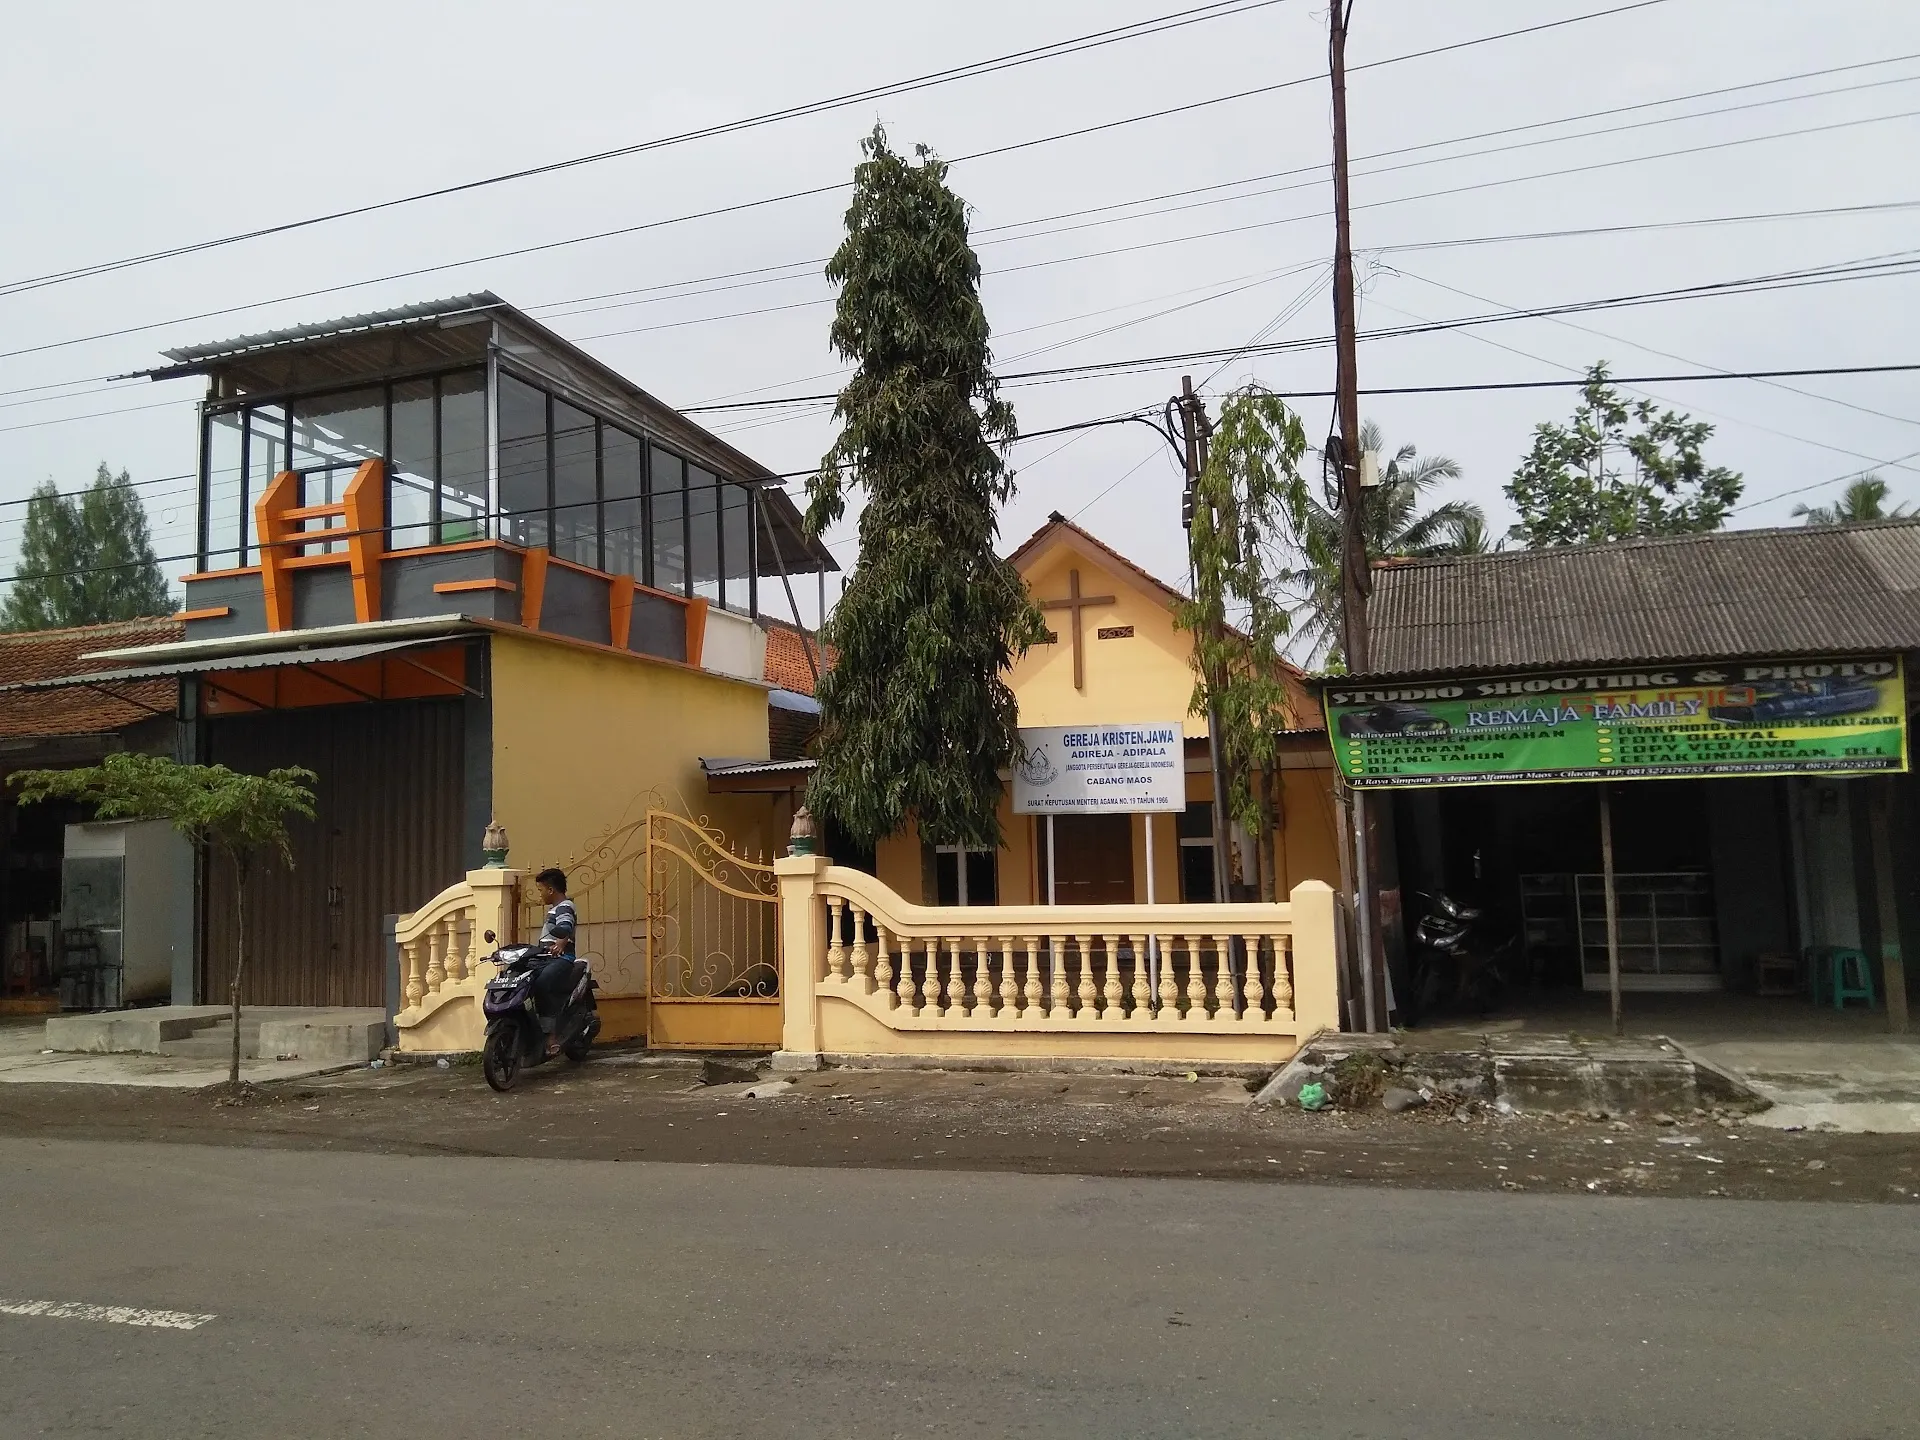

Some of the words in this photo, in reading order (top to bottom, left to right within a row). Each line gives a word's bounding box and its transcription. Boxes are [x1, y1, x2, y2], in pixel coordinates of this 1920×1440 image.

[1332, 686, 1464, 704] STUDIO
[1477, 672, 1679, 696] SHOOTING
[1693, 670, 1728, 683] &
[1744, 662, 1894, 680] PHOTO
[1467, 706, 1581, 727] REMAJA
[1592, 700, 1702, 720] FAMILY
[1350, 730, 1402, 740] Melayani
[1405, 729, 1447, 738] Segala
[1618, 725, 1664, 735] CETAK
[1668, 723, 1721, 733] PHOTO
[1063, 733, 1100, 747] GEREJA
[1366, 736, 1426, 747] PESTA
[1432, 730, 1565, 744] PERNIKAHAN
[1619, 735, 1676, 745] FOTO
[1687, 731, 1778, 742] DIGITAL
[1071, 750, 1114, 759] ADIREJA
[1122, 748, 1166, 757] ADIPALA
[1367, 744, 1466, 756] KHITANAN
[1619, 744, 1678, 754] COPY
[1367, 755, 1432, 765] ULANG
[1440, 752, 1505, 762] TAHUN
[1620, 753, 1690, 763] CETAK
[1086, 762, 1117, 771] PERSEKUTUAN
[1117, 761, 1150, 770] GEREJA-GEREJA
[1368, 766, 1403, 774] DLL
[1086, 777, 1124, 785] CABANG
[1127, 776, 1153, 784] MAOS
[1390, 776, 1432, 785] Simpang
[1447, 774, 1478, 783] depan
[1480, 773, 1524, 781] Alfamart
[1076, 798, 1099, 806] MENTERI
